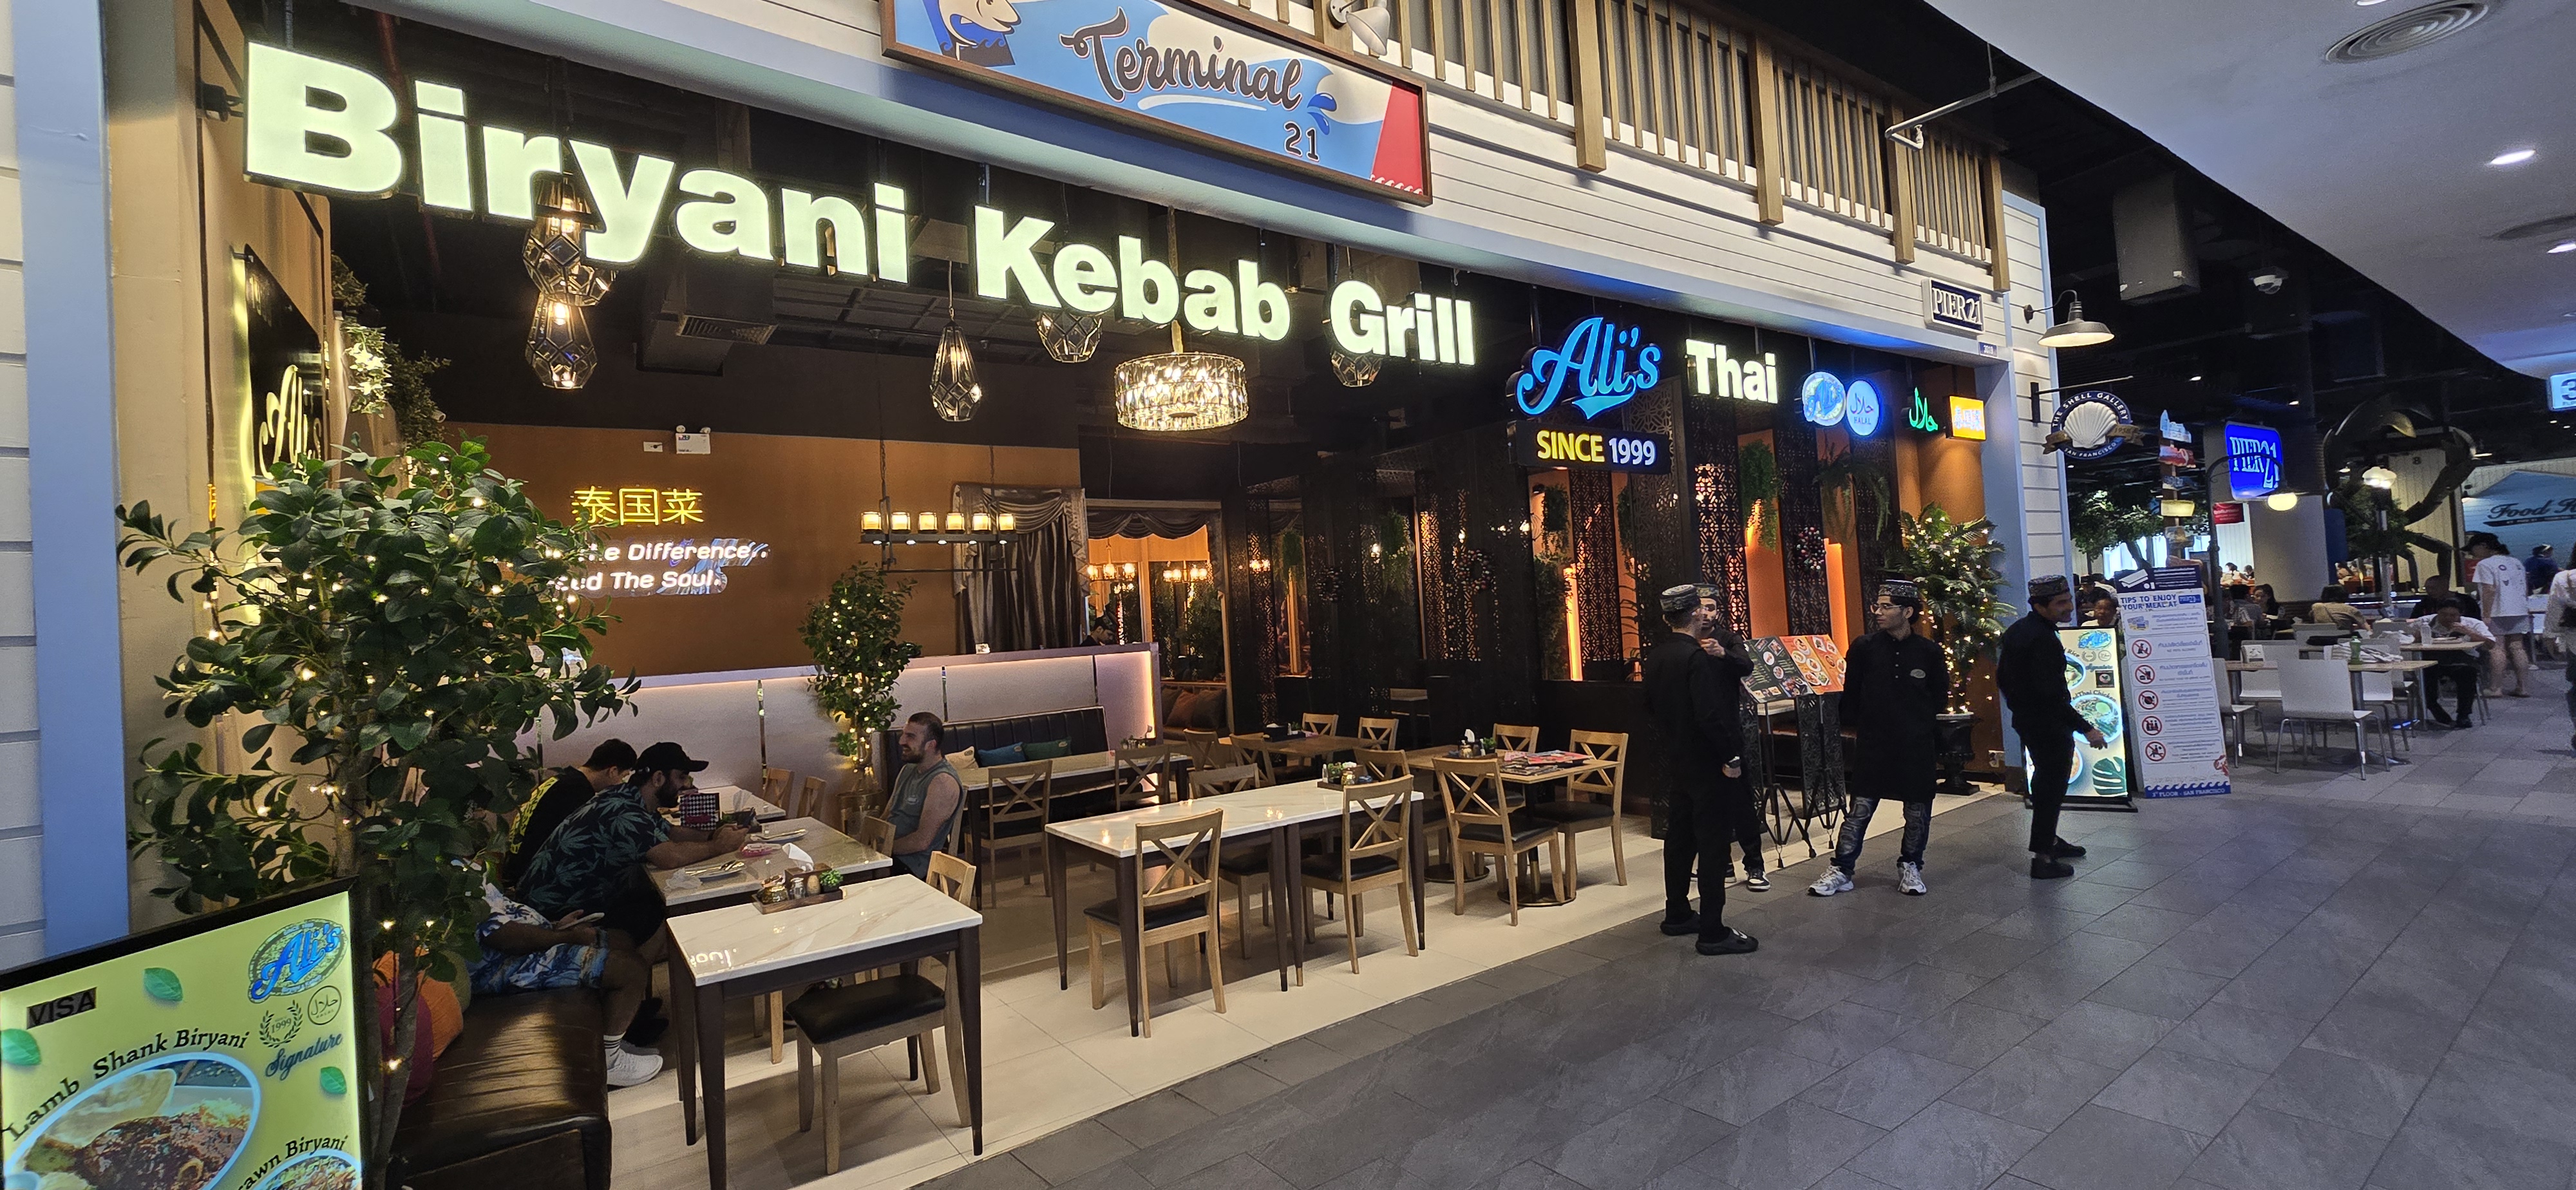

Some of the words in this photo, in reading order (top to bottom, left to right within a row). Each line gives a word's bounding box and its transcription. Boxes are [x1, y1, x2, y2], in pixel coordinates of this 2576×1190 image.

[1059, 6, 1303, 111] Terminal
[1283, 121, 1320, 162] 21
[243, 41, 909, 284] Biryani
[974, 205, 1291, 341] Kebab
[1330, 281, 1476, 366] Grill
[1515, 315, 1662, 420] Ali's
[1685, 338, 1778, 404] Thai
[1850, 392, 1874, 414] حلال
[1909, 386, 1938, 431] حلال
[2052, 411, 2063, 428] THE
[2063, 392, 2092, 409] SHELL
[2097, 392, 2128, 420] GALLERY
[1537, 430, 1604, 464] SINCE
[1609, 437, 1657, 466] 1999
[2064, 447, 2077, 456] SAN
[2079, 442, 2116, 457] FRANCISCO
[571, 486, 704, 526] 泰国菜
[2486, 498, 2555, 519] Food
[610, 572, 654, 589] The
[251, 922, 342, 1000] Ali's
[29, 990, 96, 1026] VISA
[310, 994, 338, 1015] حلال
[271, 1017, 292, 1034] 1999
[265, 1032, 343, 1081] Signature
[1, 1077, 80, 1142] Lamb
[93, 1032, 168, 1080] Shank
[173, 1028, 250, 1051] Biryani
[236, 1154, 281, 1190] rawn
[285, 1135, 348, 1159] Biryani
